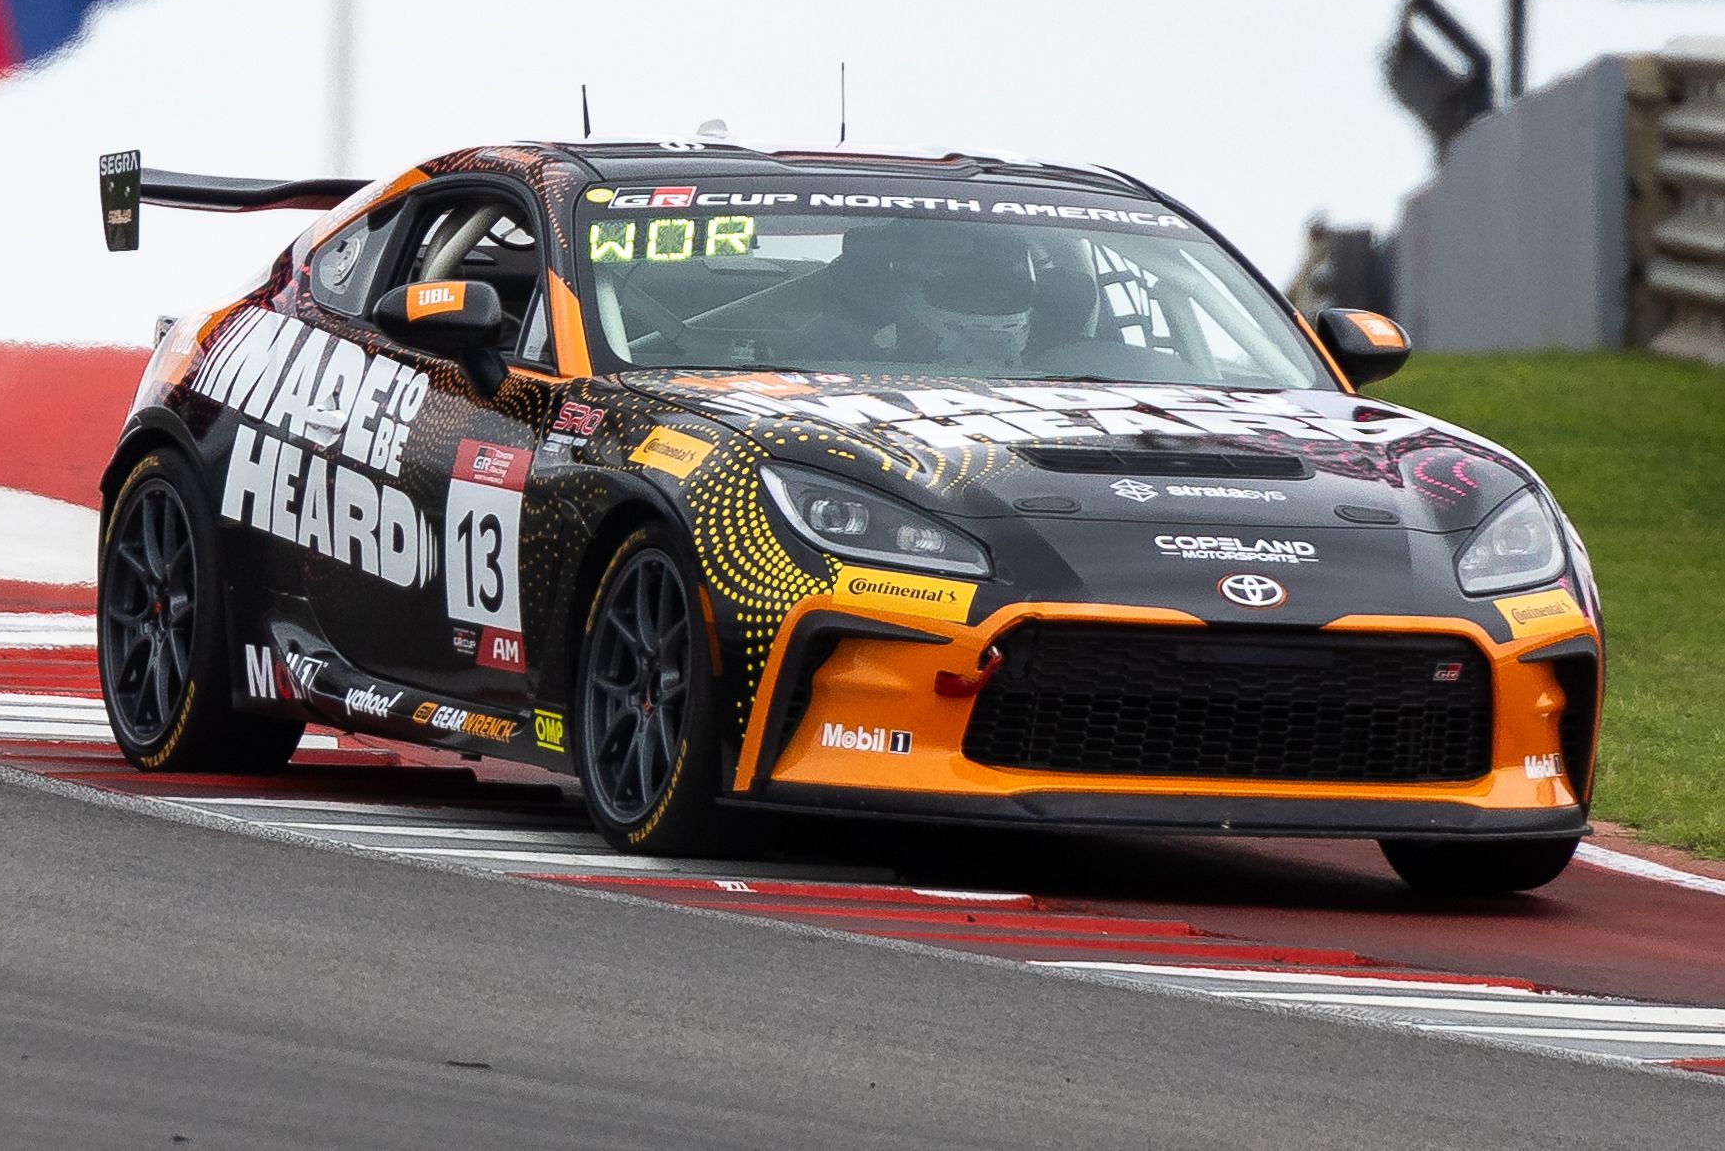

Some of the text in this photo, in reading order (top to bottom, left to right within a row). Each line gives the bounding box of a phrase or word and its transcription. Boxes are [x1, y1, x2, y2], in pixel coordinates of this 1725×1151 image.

[100, 152, 138, 176] SEGRA
[612, 193, 1189, 229] GR CUP NORTH AMERICA
[589, 215, 755, 262] WOR
[418, 288, 455, 306] JBL
[208, 309, 430, 464] MADE TO
[369, 417, 410, 478] BE
[473, 456, 492, 470] GR
[220, 423, 419, 588] HEARD
[1166, 485, 1287, 501] stratasys
[1154, 535, 1316, 556] COPELAND
[1182, 550, 1299, 564] MOTORSPORTS
[456, 510, 504, 614] 13
[848, 578, 943, 602] Continental
[493, 637, 519, 663] AM
[345, 685, 404, 718] yahoo!
[431, 706, 517, 741] GEARWRENCH
[535, 716, 563, 744] OMP
[821, 722, 885, 752] Mobil
